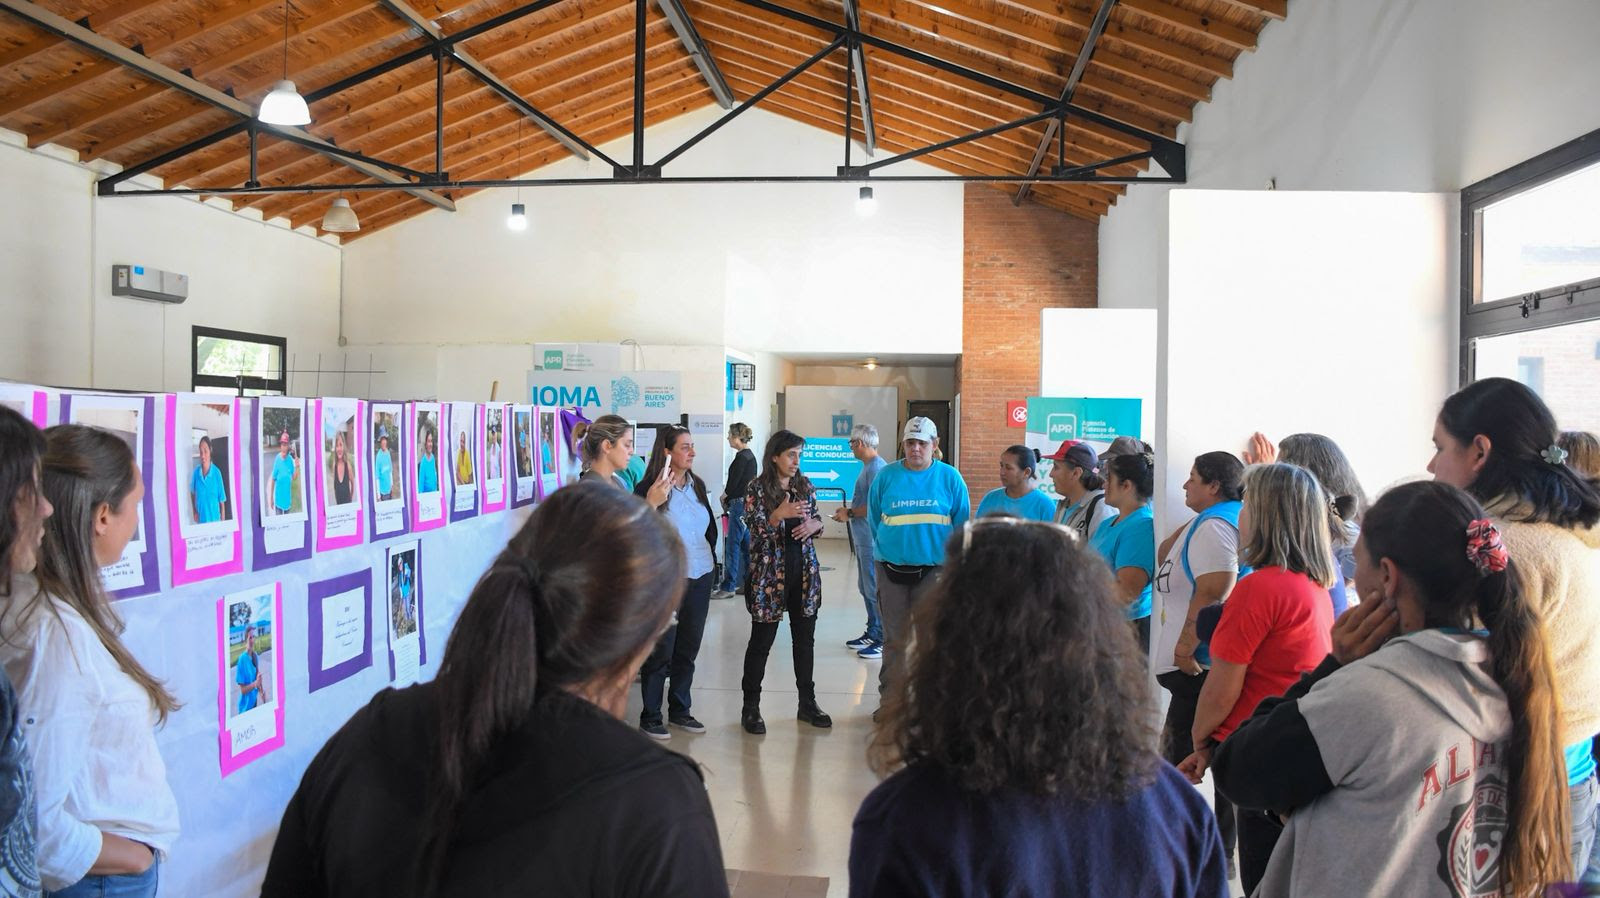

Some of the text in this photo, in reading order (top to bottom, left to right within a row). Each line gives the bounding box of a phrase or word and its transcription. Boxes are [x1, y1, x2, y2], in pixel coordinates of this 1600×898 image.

[545, 356, 562, 364] APR
[532, 386, 601, 407] IOMA
[1050, 424, 1073, 433] APR
[1039, 483, 1056, 493] CO
[891, 499, 940, 509] LIMPIEZA
